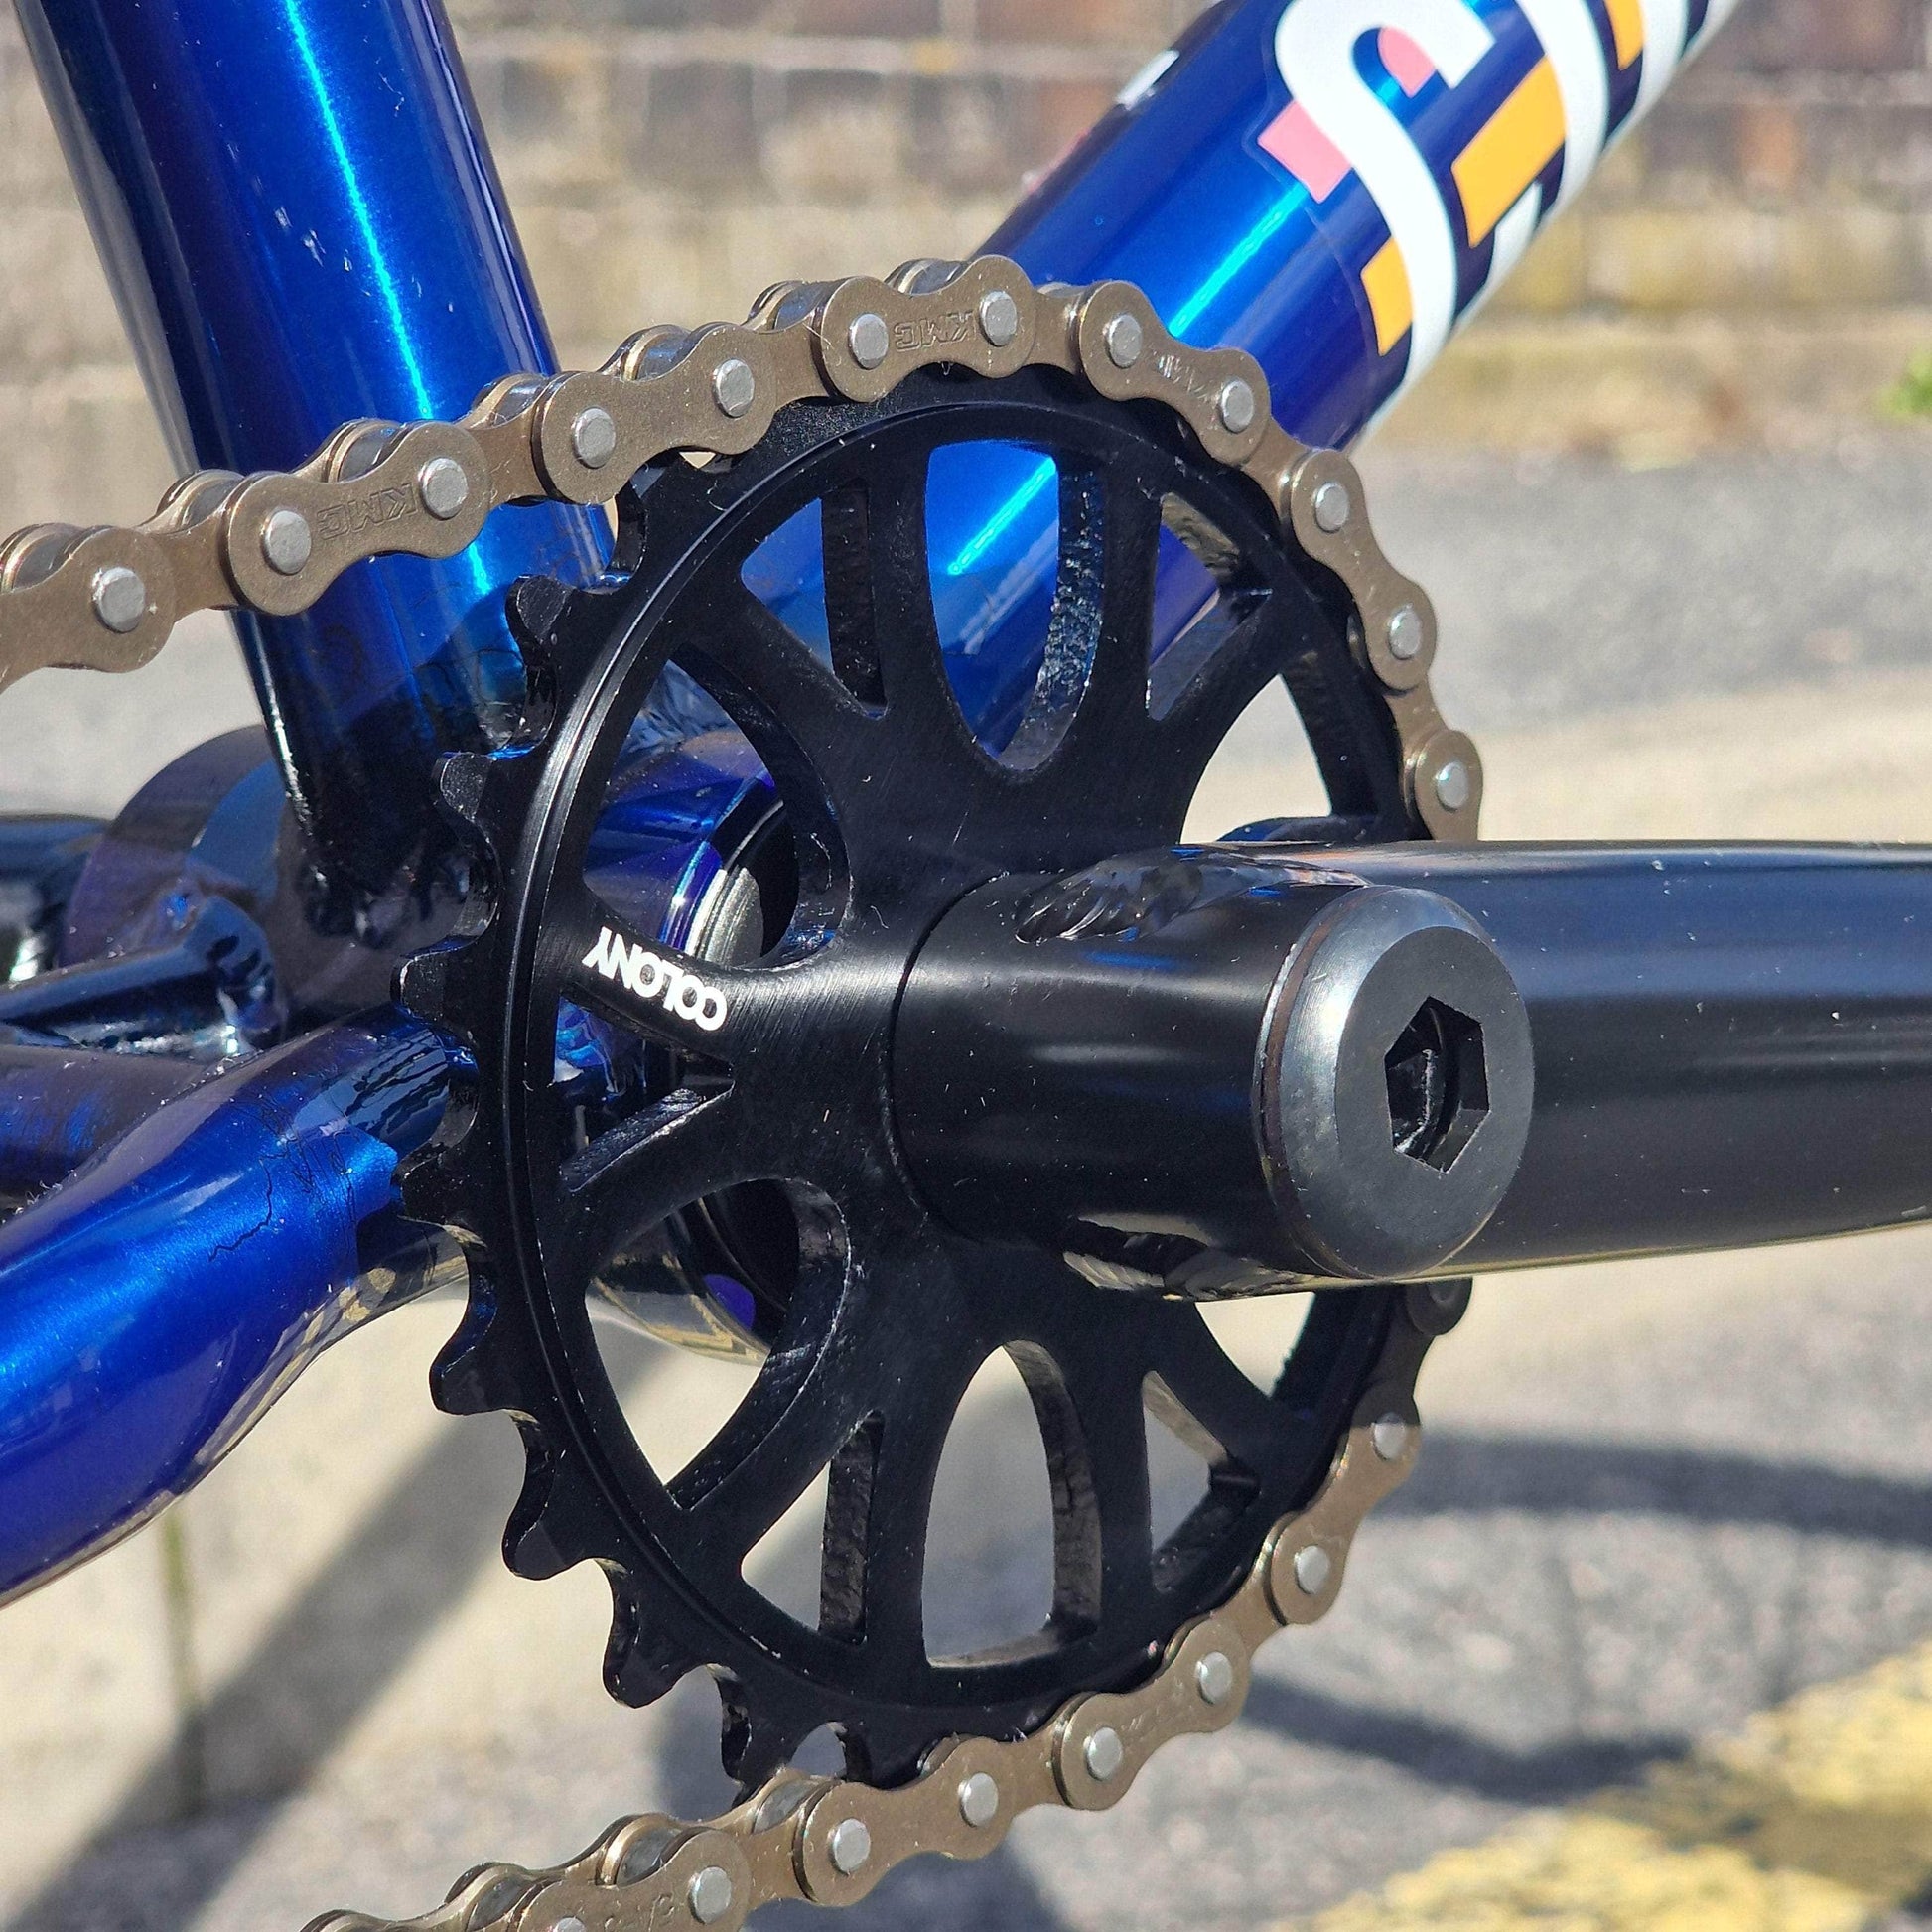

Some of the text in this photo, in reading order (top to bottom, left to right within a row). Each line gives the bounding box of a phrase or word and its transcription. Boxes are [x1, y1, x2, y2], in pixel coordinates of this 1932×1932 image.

[894, 310, 975, 352] KMC
[317, 483, 419, 541] KMC
[582, 925, 729, 1032] COLONY
